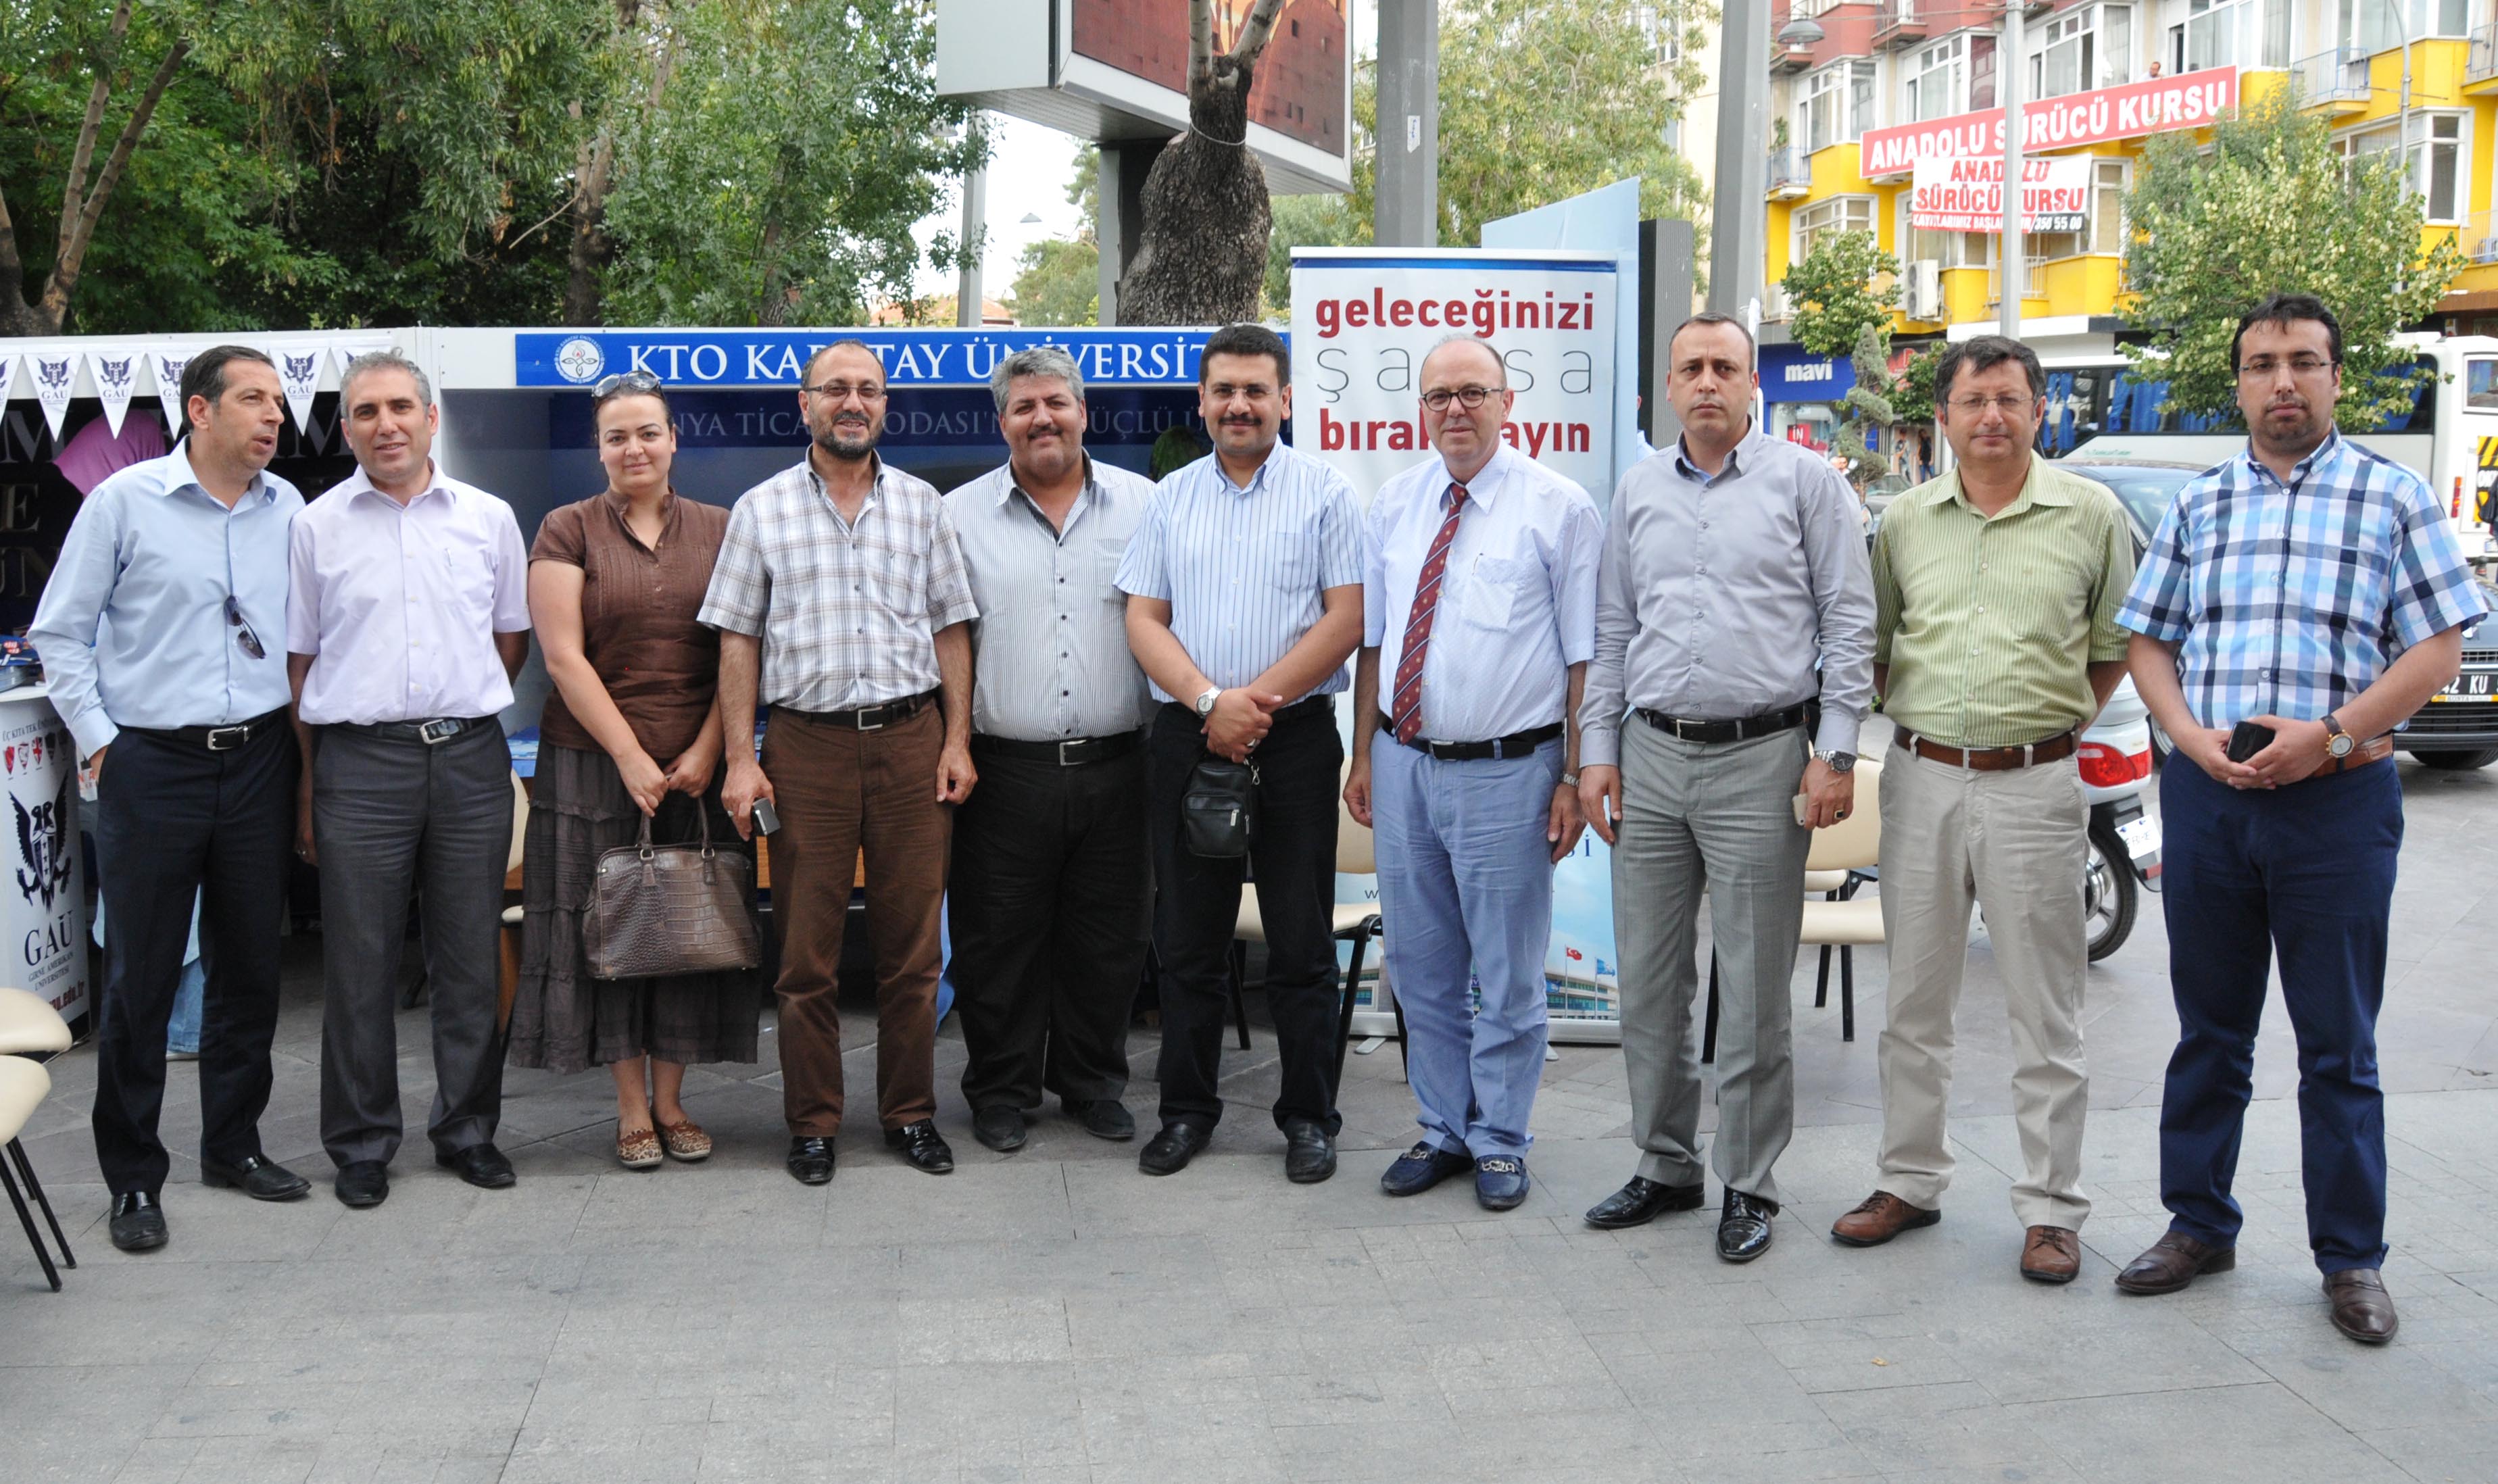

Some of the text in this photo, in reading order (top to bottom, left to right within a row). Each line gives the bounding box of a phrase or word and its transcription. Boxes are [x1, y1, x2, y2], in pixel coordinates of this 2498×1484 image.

[1869, 122, 1986, 170] ANADOLU
[2118, 80, 2228, 130] KURSU
[1950, 160, 2051, 182] ANADLU
[1915, 183, 2085, 212] SÜRÜCÜ URSU
[2034, 216, 2083, 230] 350 55 00
[1315, 287, 1594, 339] geleceğinizi
[627, 344, 728, 381] KTO
[743, 343, 953, 380] KATAY
[1316, 347, 1592, 403] şasa
[1784, 359, 1833, 382] mavi
[163, 389, 181, 397] GA
[735, 407, 810, 437] TİCA
[1089, 405, 1173, 439] ÜÇLÜ
[1319, 407, 1590, 461] bıraayın
[2469, 674, 2489, 695] KU
